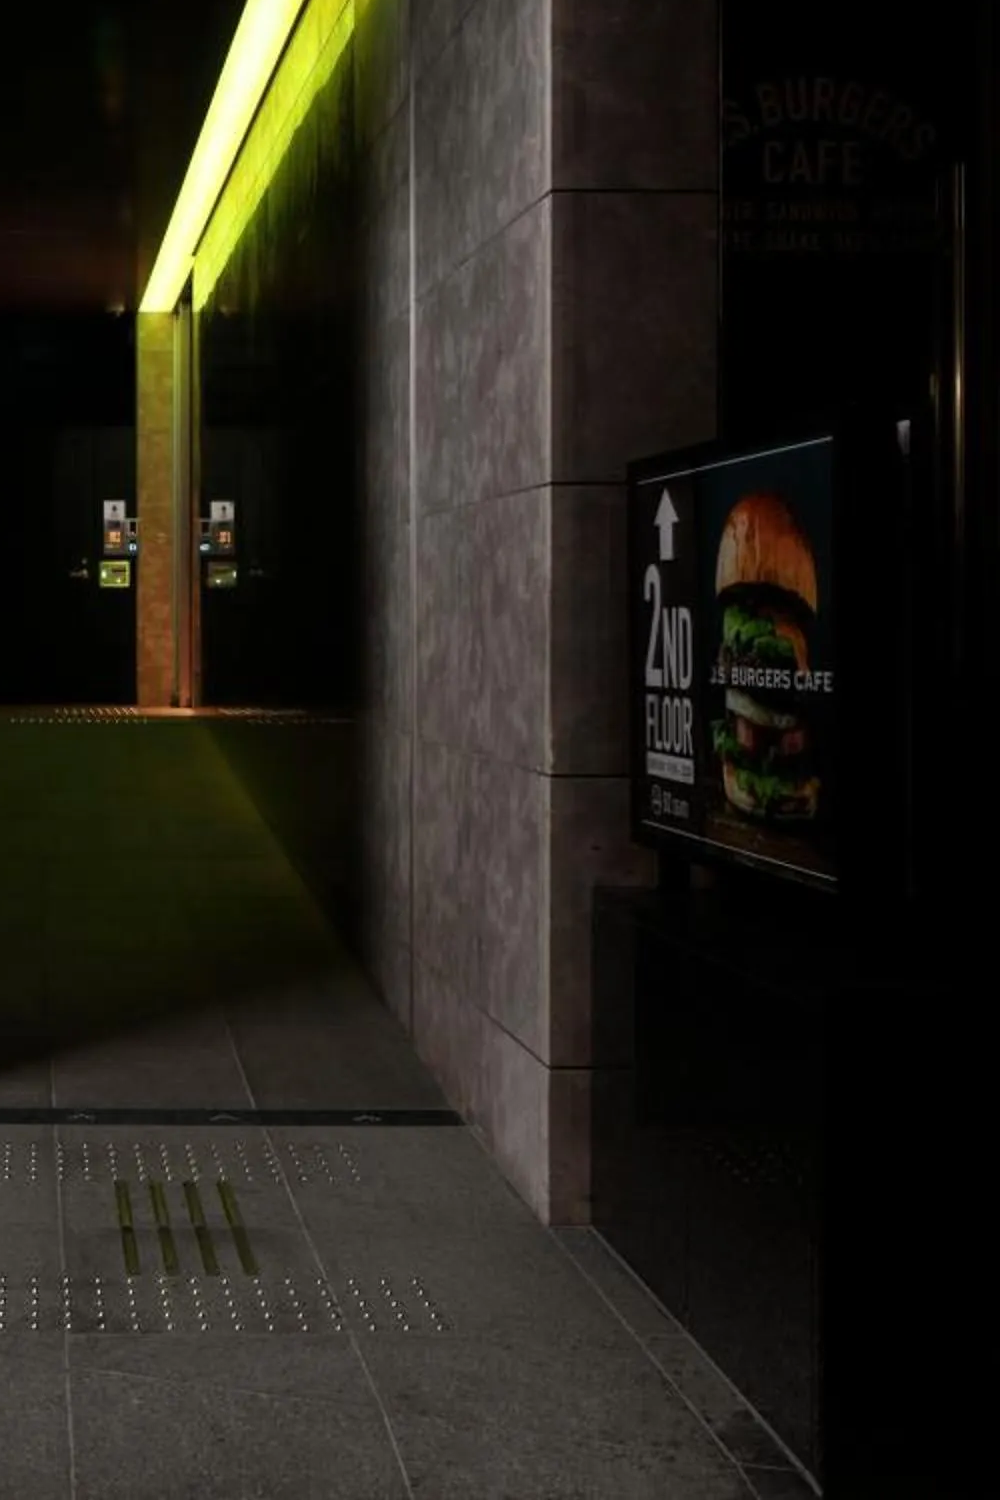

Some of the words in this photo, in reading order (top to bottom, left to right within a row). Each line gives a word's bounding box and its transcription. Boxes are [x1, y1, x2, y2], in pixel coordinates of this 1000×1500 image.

[643, 563, 693, 691] 2ND
[731, 666, 791, 690] BURGERS
[794, 669, 834, 693] CAFE
[645, 693, 694, 756] FLOOR
